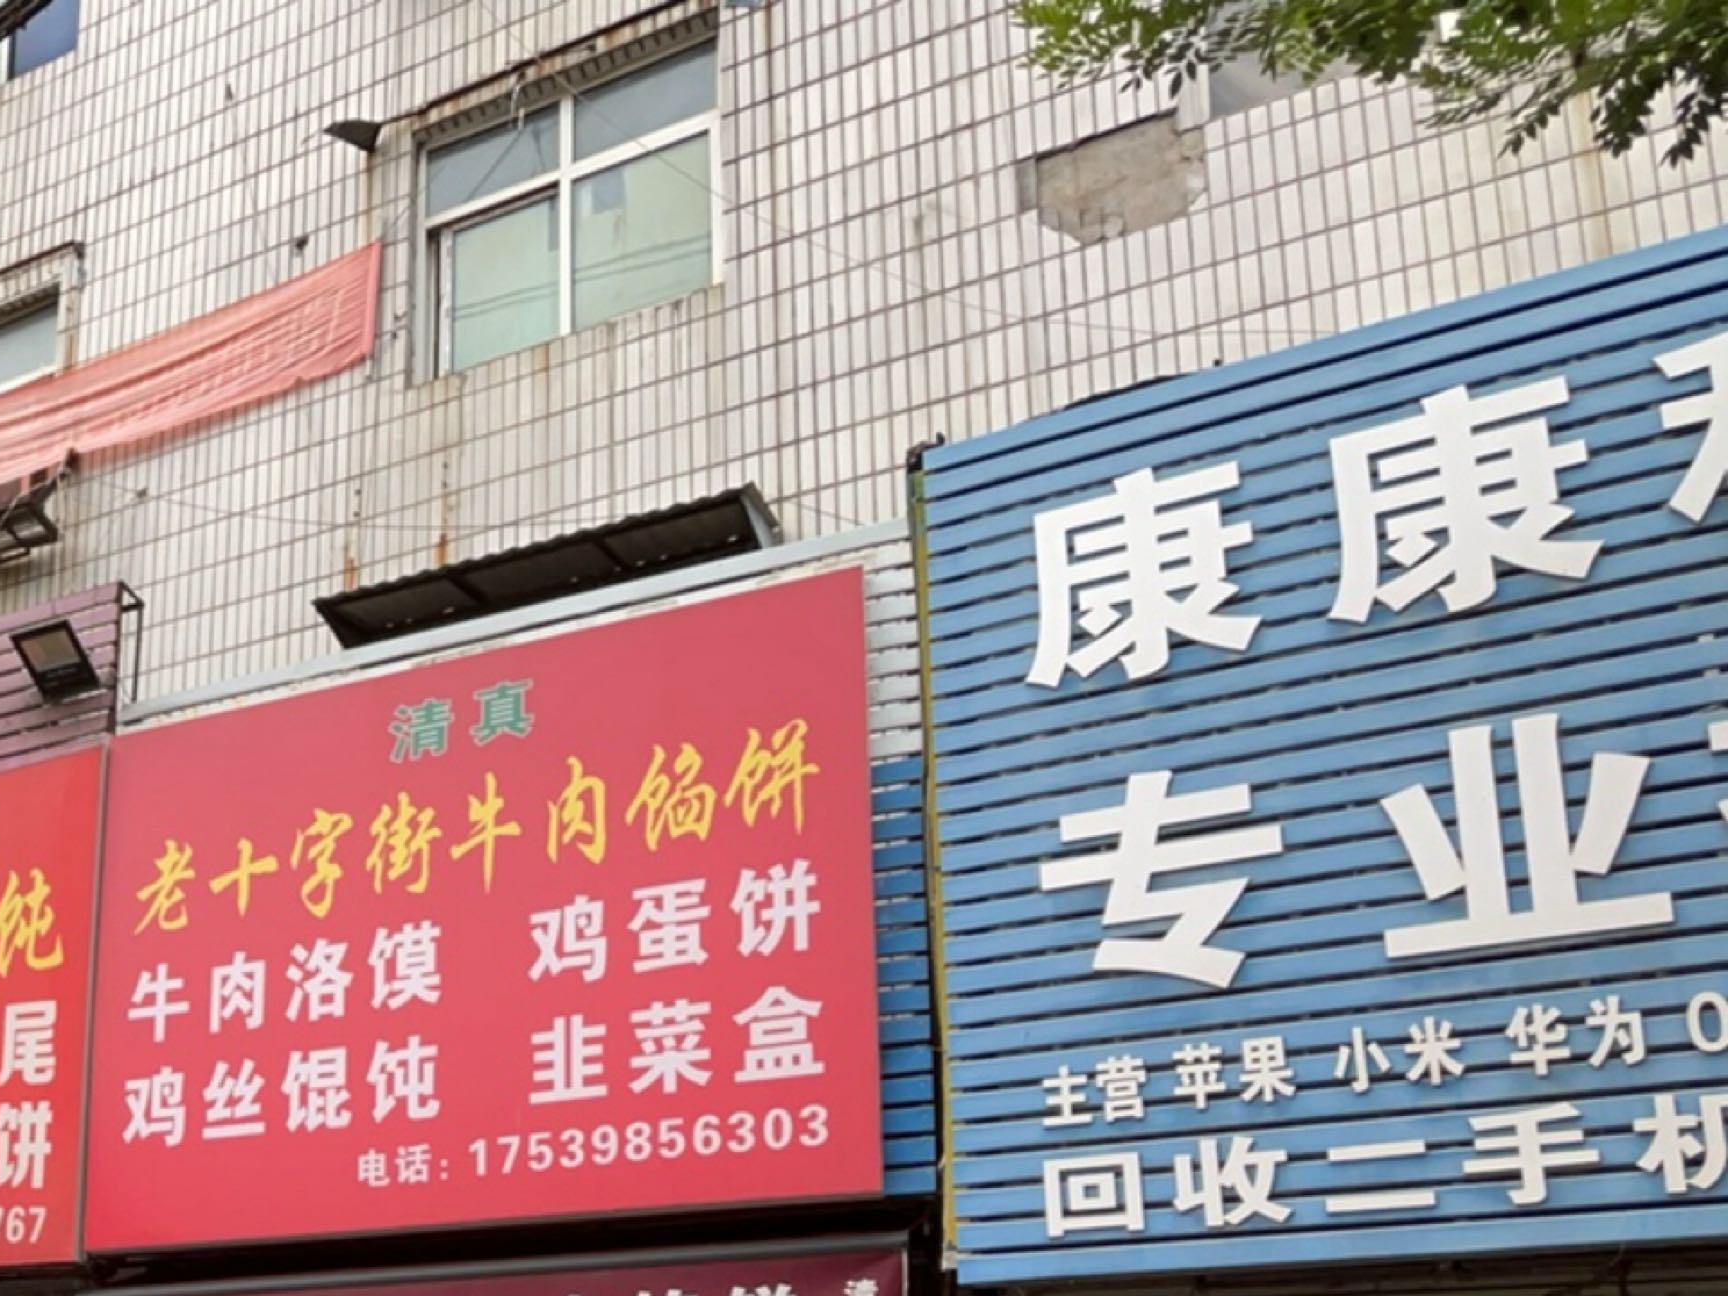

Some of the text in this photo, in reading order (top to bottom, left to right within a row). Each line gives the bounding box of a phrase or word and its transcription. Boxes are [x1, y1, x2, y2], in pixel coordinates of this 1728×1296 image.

[388, 677, 536, 764] 清真
[133, 718, 820, 936] 老十字街牛肉馅饼
[1039, 712, 1728, 988] 专业
[128, 857, 821, 1042] 牛肉洛馍 鸡蛋饼
[122, 985, 825, 1148] 鸡丝馄饨 韭菜盒
[1042, 1052, 1146, 1128] 主营
[1172, 1035, 1297, 1111] 苹果
[1333, 1015, 1465, 1095] 小米
[1506, 994, 1646, 1078] 华为
[468, 1104, 830, 1177] 17539856303
[1042, 1091, 1728, 1238] 回收二手机
